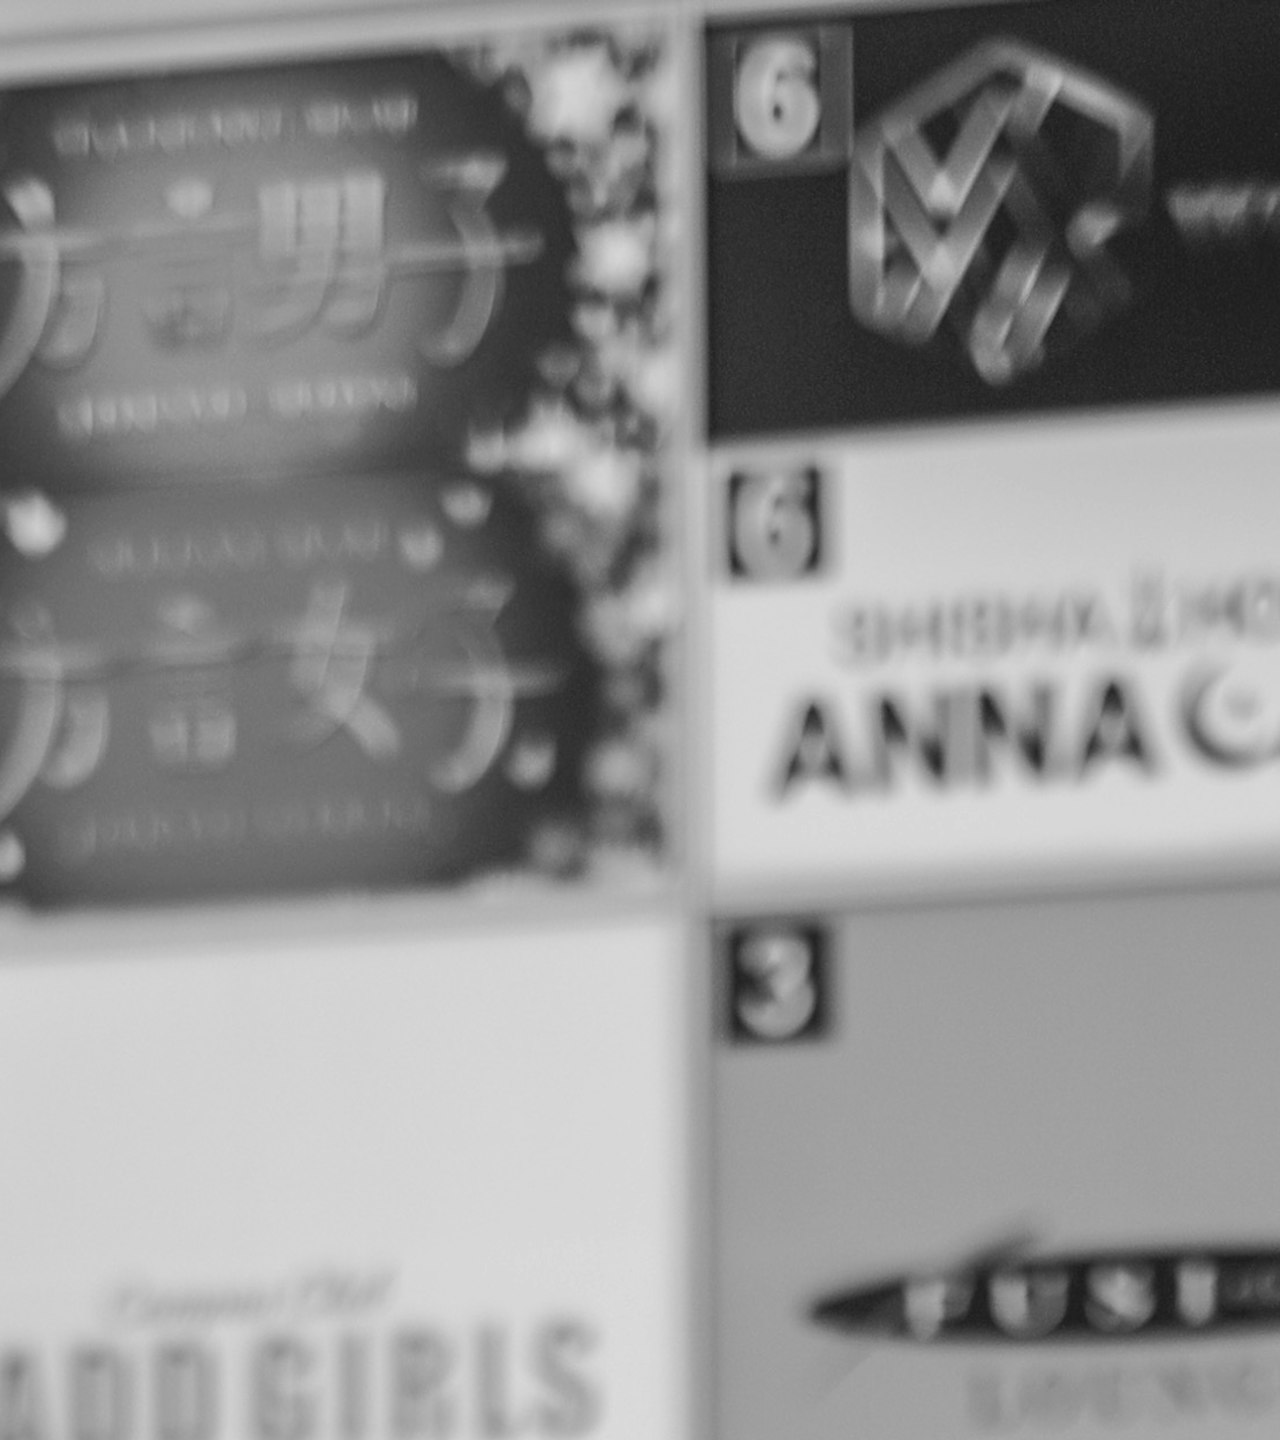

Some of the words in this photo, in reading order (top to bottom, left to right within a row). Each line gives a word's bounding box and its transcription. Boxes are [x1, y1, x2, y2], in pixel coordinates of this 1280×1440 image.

[733, 37, 822, 160] 6
[733, 470, 815, 578] 6
[768, 682, 1160, 803] ANNA
[734, 930, 816, 1042] 3
